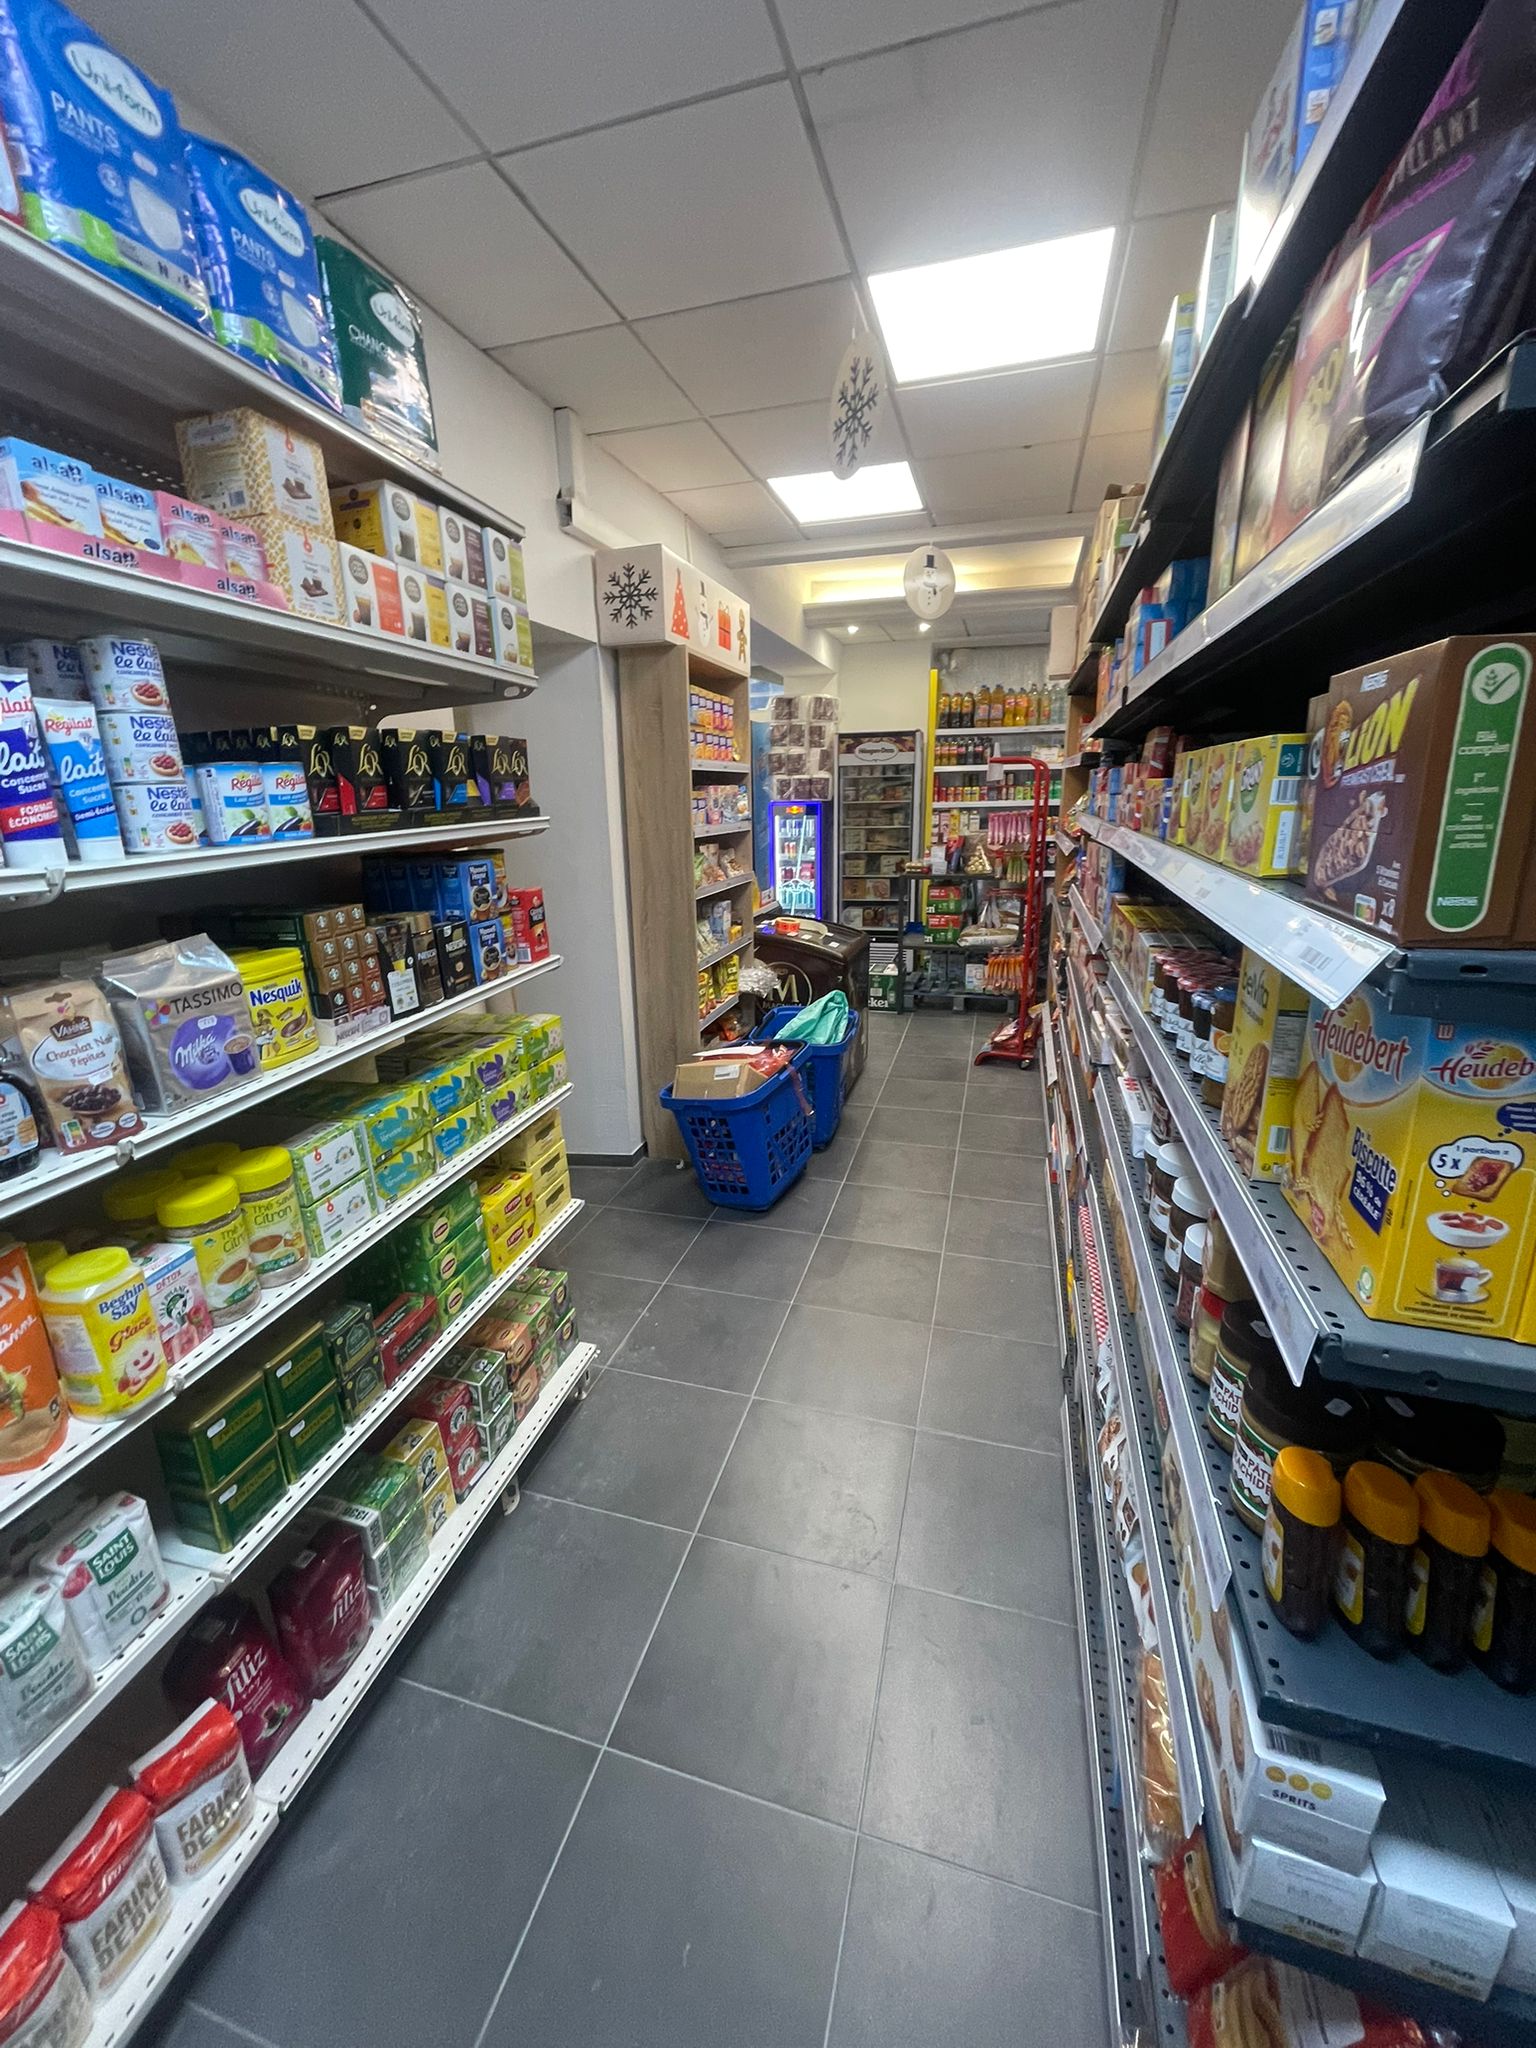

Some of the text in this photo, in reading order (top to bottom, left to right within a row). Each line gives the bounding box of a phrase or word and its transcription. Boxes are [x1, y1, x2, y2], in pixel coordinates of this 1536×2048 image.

[51, 89, 120, 149] PANTS
[230, 226, 277, 270] PANTS
[115, 656, 136, 669] le
[45, 716, 95, 737] Régilait
[130, 716, 176, 731] Nestlé
[134, 730, 152, 742] le
[1343, 678, 1420, 773] LION
[0, 739, 46, 776] lait
[308, 743, 334, 778] L'OR
[357, 744, 383, 778] L'OR
[405, 744, 432, 777] L'OR
[445, 745, 467, 777] L'OR
[1458, 743, 1511, 757] complet
[60, 750, 106, 785] lait
[20, 801, 54, 816] FORMAT
[147, 787, 191, 802] Nestlé
[151, 800, 168, 813] le
[170, 982, 244, 1016] TASSIMO
[250, 979, 303, 1007] Nesquik
[46, 1040, 94, 1063] Chocolat
[70, 1049, 106, 1068] Pépites
[175, 1031, 216, 1069] Milka
[1314, 1009, 1411, 1081] Heudebert
[1430, 1057, 1536, 1085] Heudeb
[1352, 1127, 1398, 1195] Biscotte
[1436, 1153, 1448, 1169] 5
[1462, 1146, 1500, 1156] portion
[252, 1202, 274, 1215] Thé
[254, 1205, 293, 1227] Citron
[98, 1281, 146, 1315] Beghin
[111, 1297, 140, 1321] Say
[1223, 1386, 1242, 1406] PÂT
[91, 1534, 131, 1572] SAINT
[99, 1543, 135, 1580] LOUIS
[107, 1570, 145, 1607] Poudre
[225, 1648, 267, 1708] filiz
[1271, 1789, 1316, 1812] SPRITS
